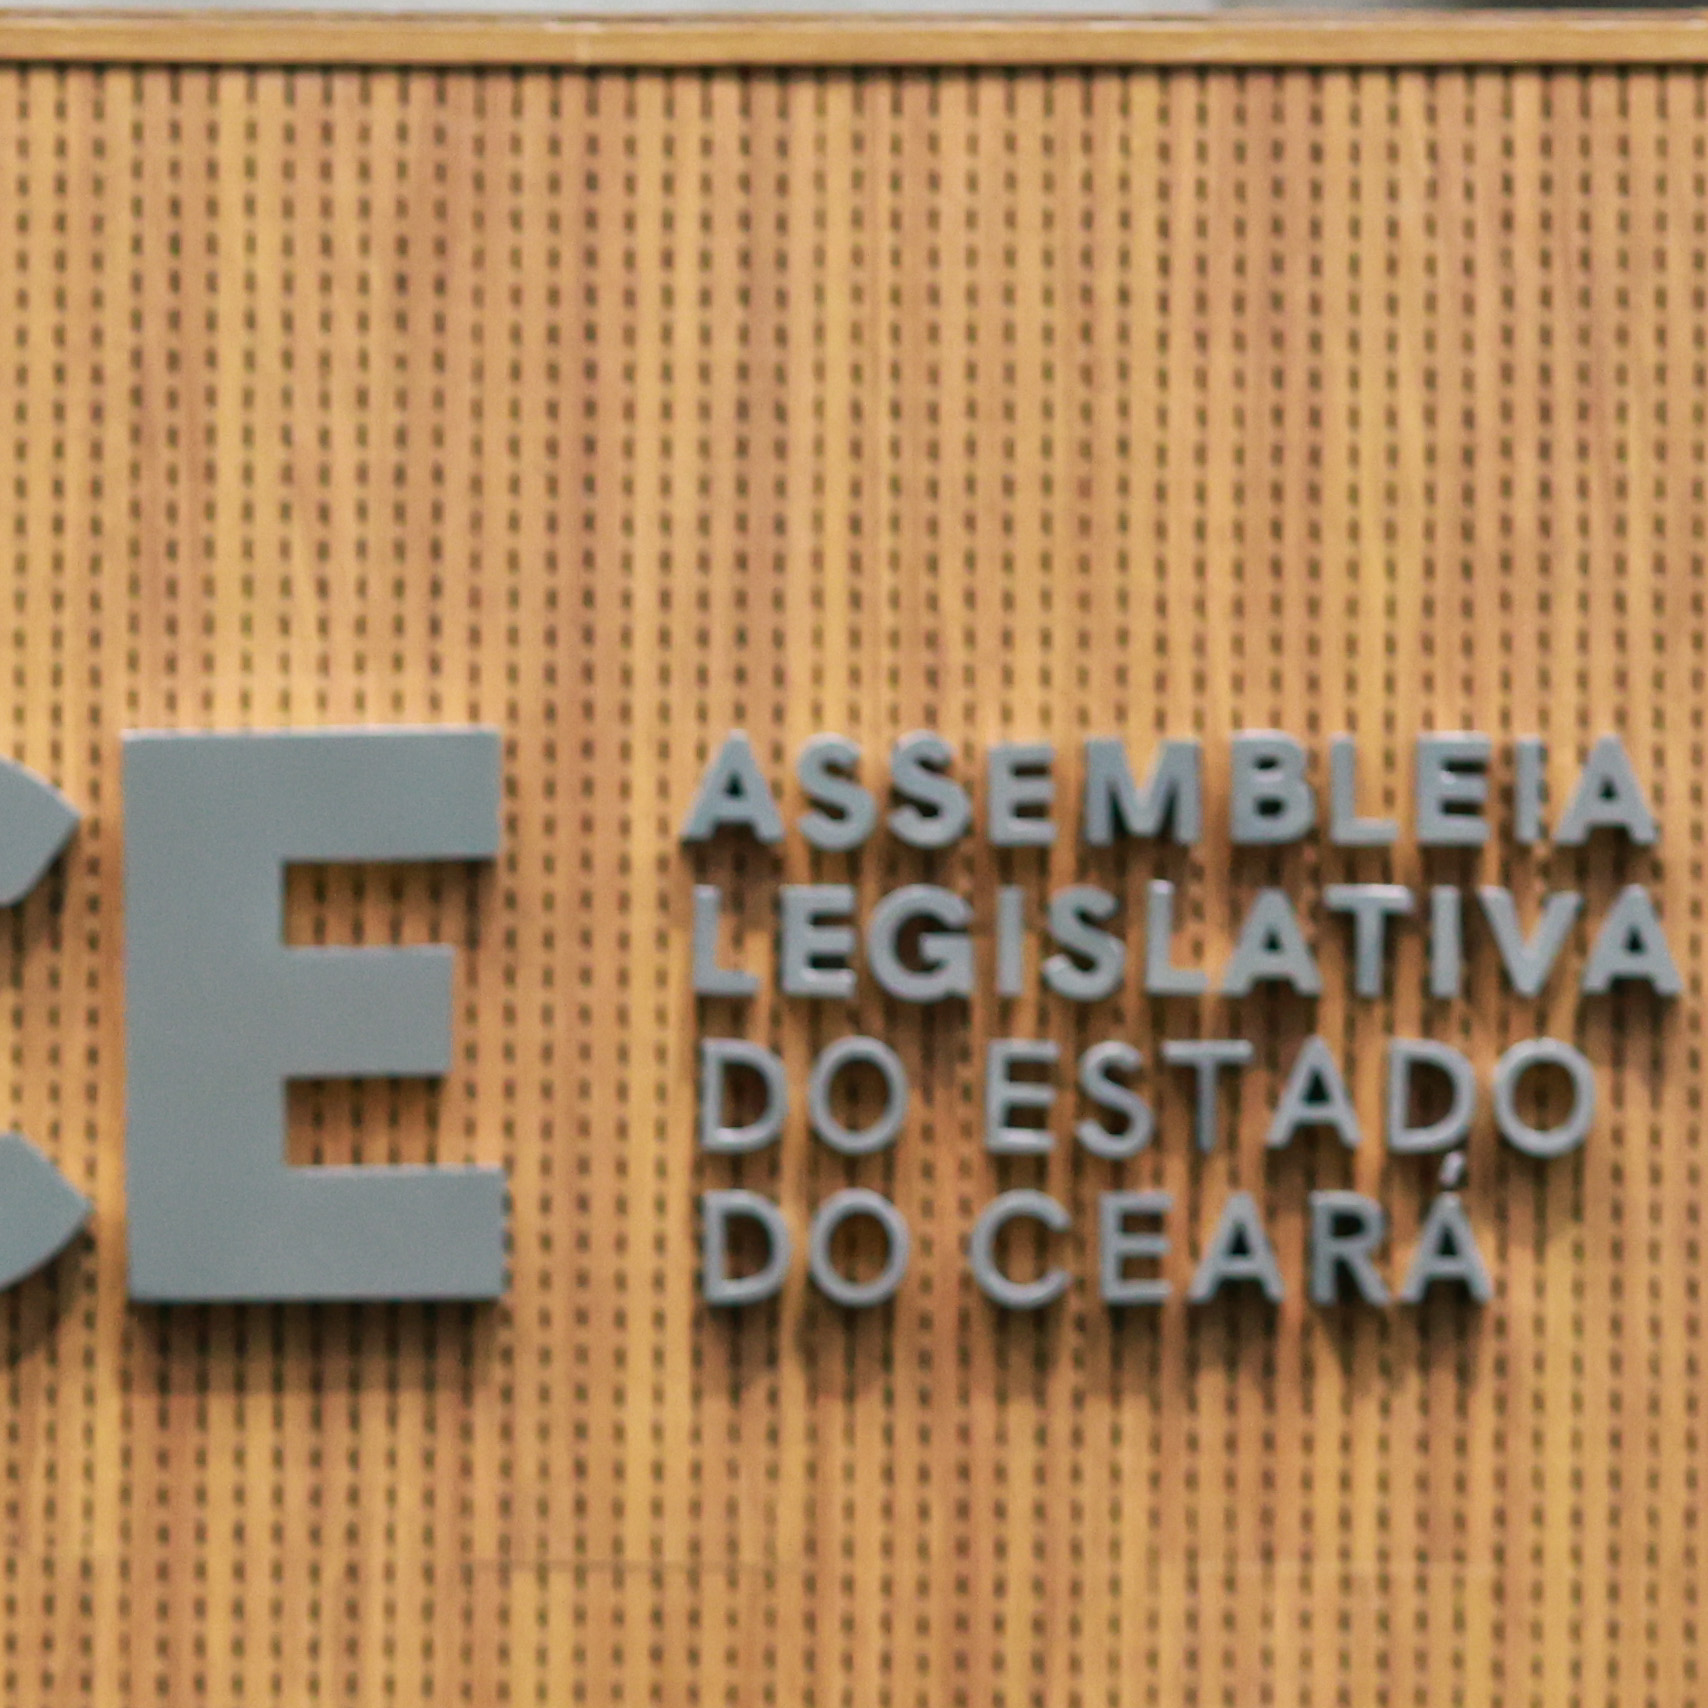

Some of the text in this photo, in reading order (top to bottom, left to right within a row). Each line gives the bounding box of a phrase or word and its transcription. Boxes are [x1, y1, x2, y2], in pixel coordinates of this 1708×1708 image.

[681, 728, 1659, 852] ASSEMBLEIA
[691, 878, 1683, 1002] LEGISLATIVA
[701, 1033, 1597, 1160] DO ESTADO
[701, 1151, 1493, 1309] DO CEARÁ
